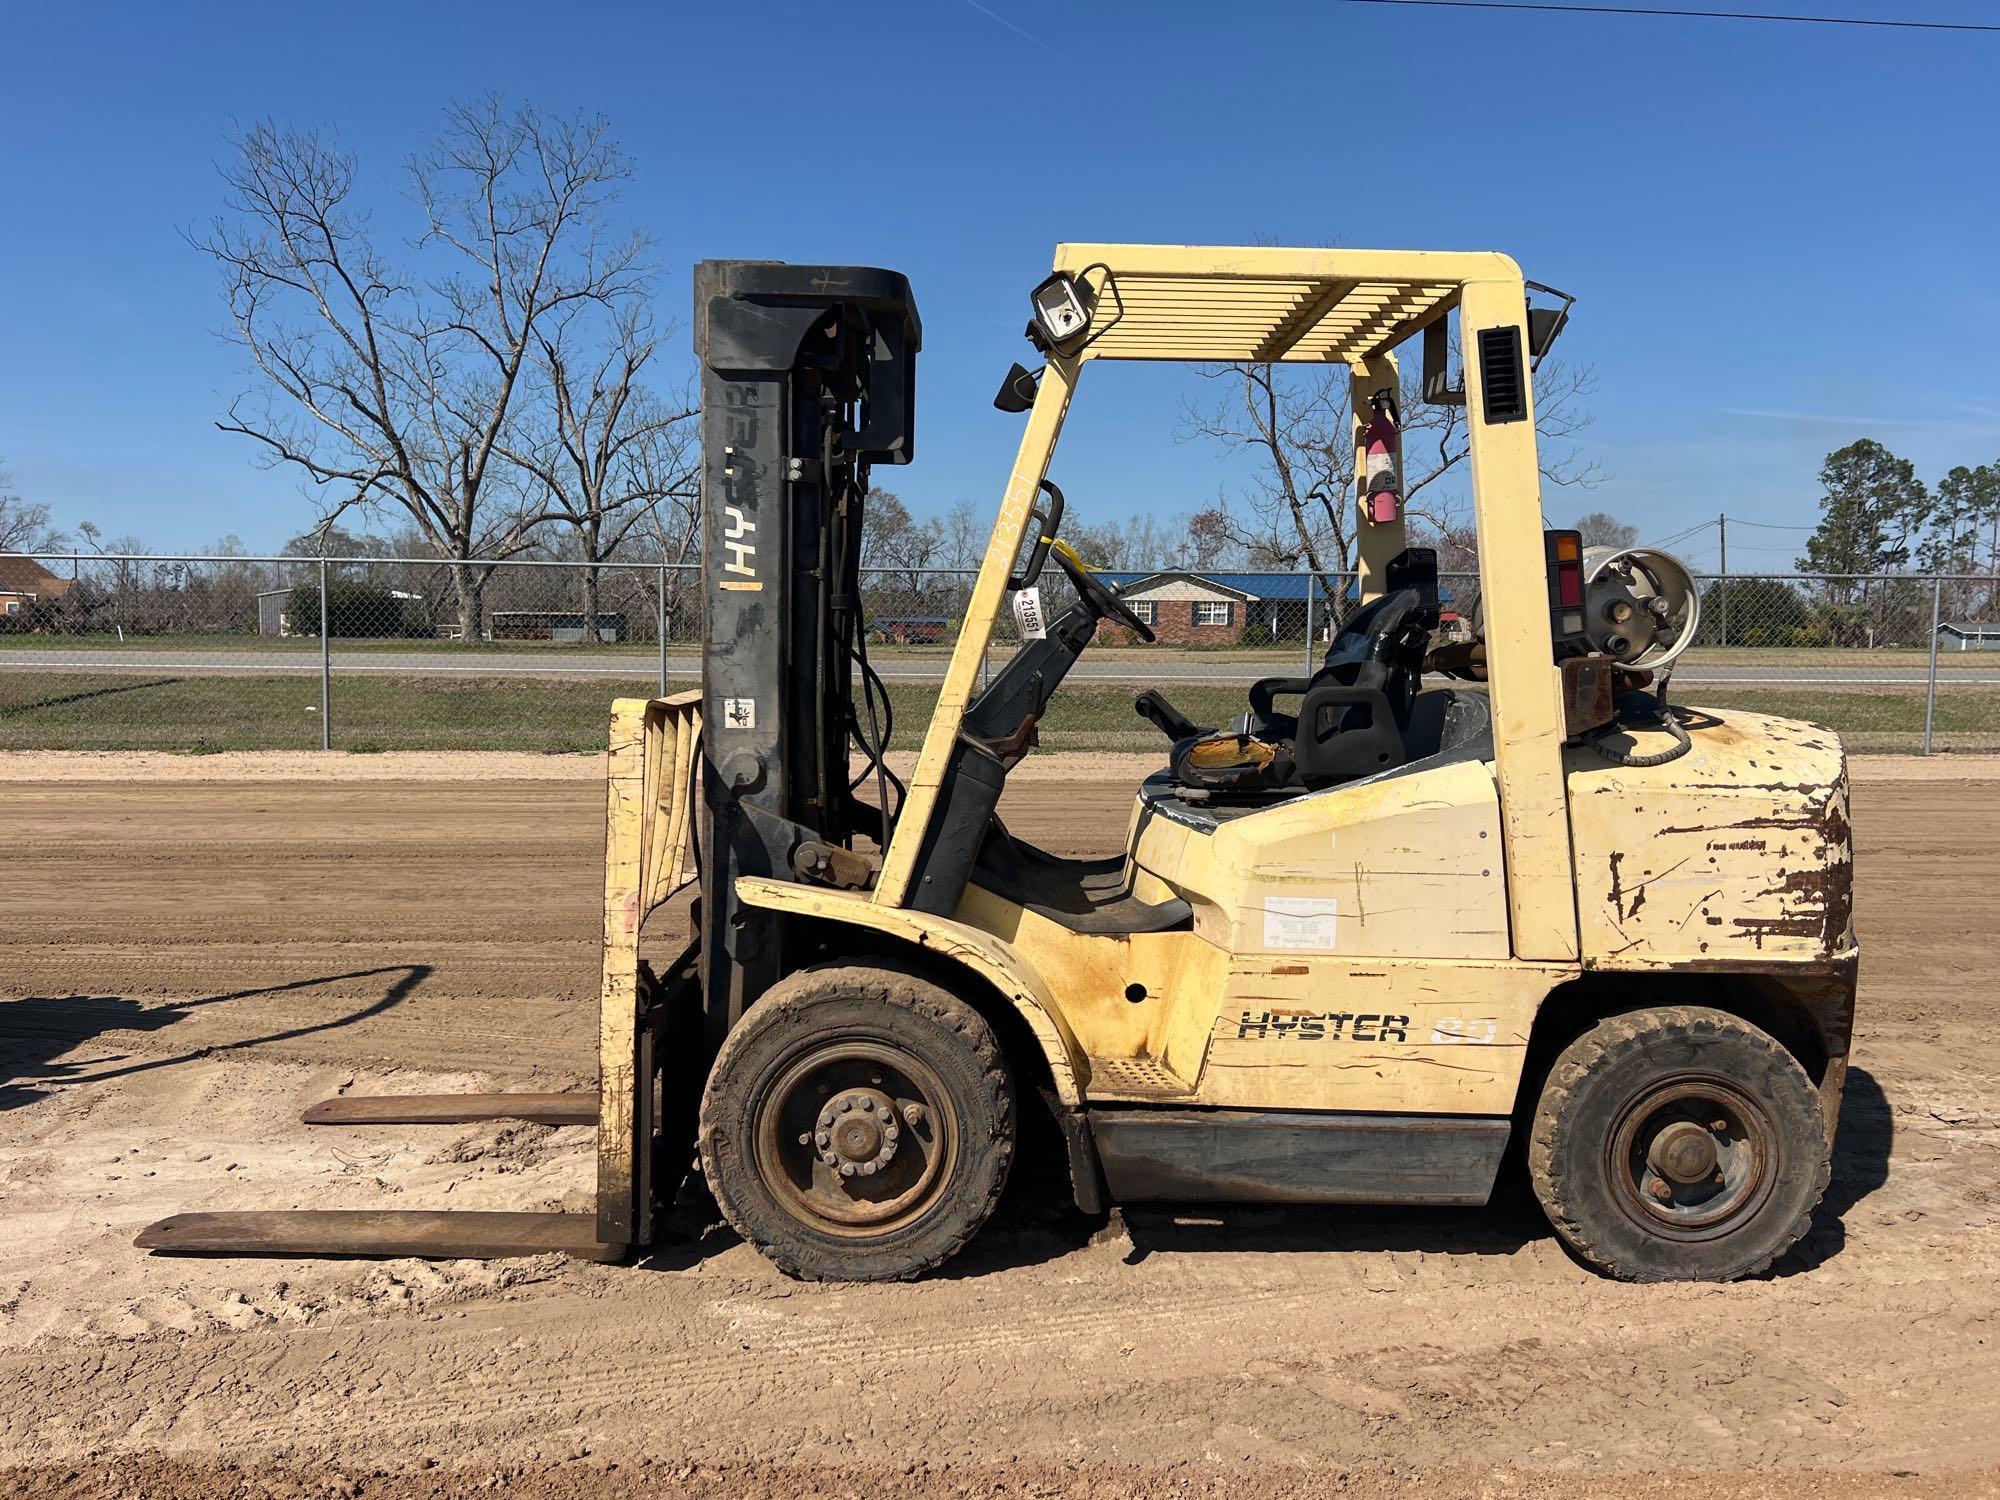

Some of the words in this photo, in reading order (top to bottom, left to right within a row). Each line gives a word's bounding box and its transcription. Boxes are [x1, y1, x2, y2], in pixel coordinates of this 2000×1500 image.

[991, 473, 1036, 571] 213551
[1022, 599, 1040, 632] 213551
[1238, 1011, 1410, 1042] HYSTER
[1431, 1016, 1497, 1044] 80
